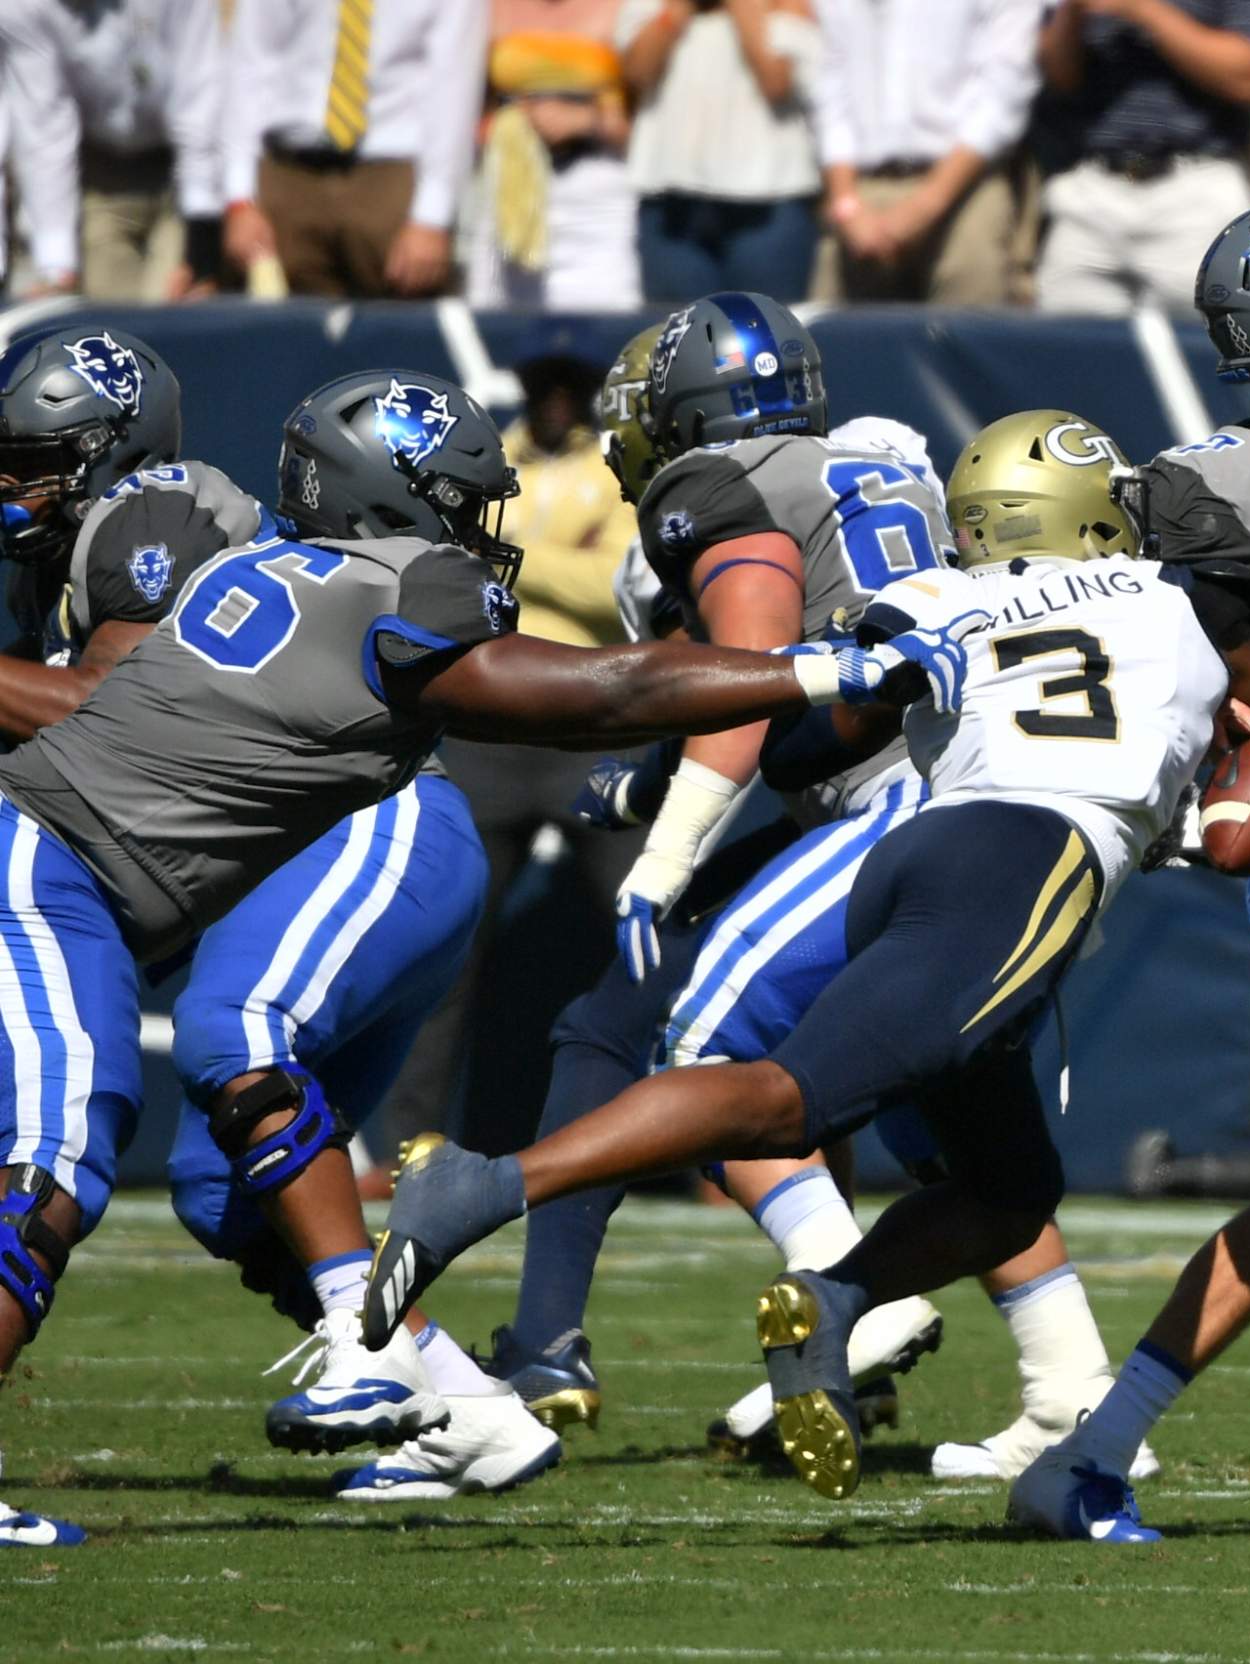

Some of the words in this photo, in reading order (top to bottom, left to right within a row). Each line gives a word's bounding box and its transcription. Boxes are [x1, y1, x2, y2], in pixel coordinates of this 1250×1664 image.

[756, 358, 778, 372] MD
[1045, 422, 1134, 478] GT
[820, 458, 959, 595] 6
[173, 501, 351, 675] 6
[966, 571, 1144, 636] ILLING
[988, 624, 1122, 745] 3
